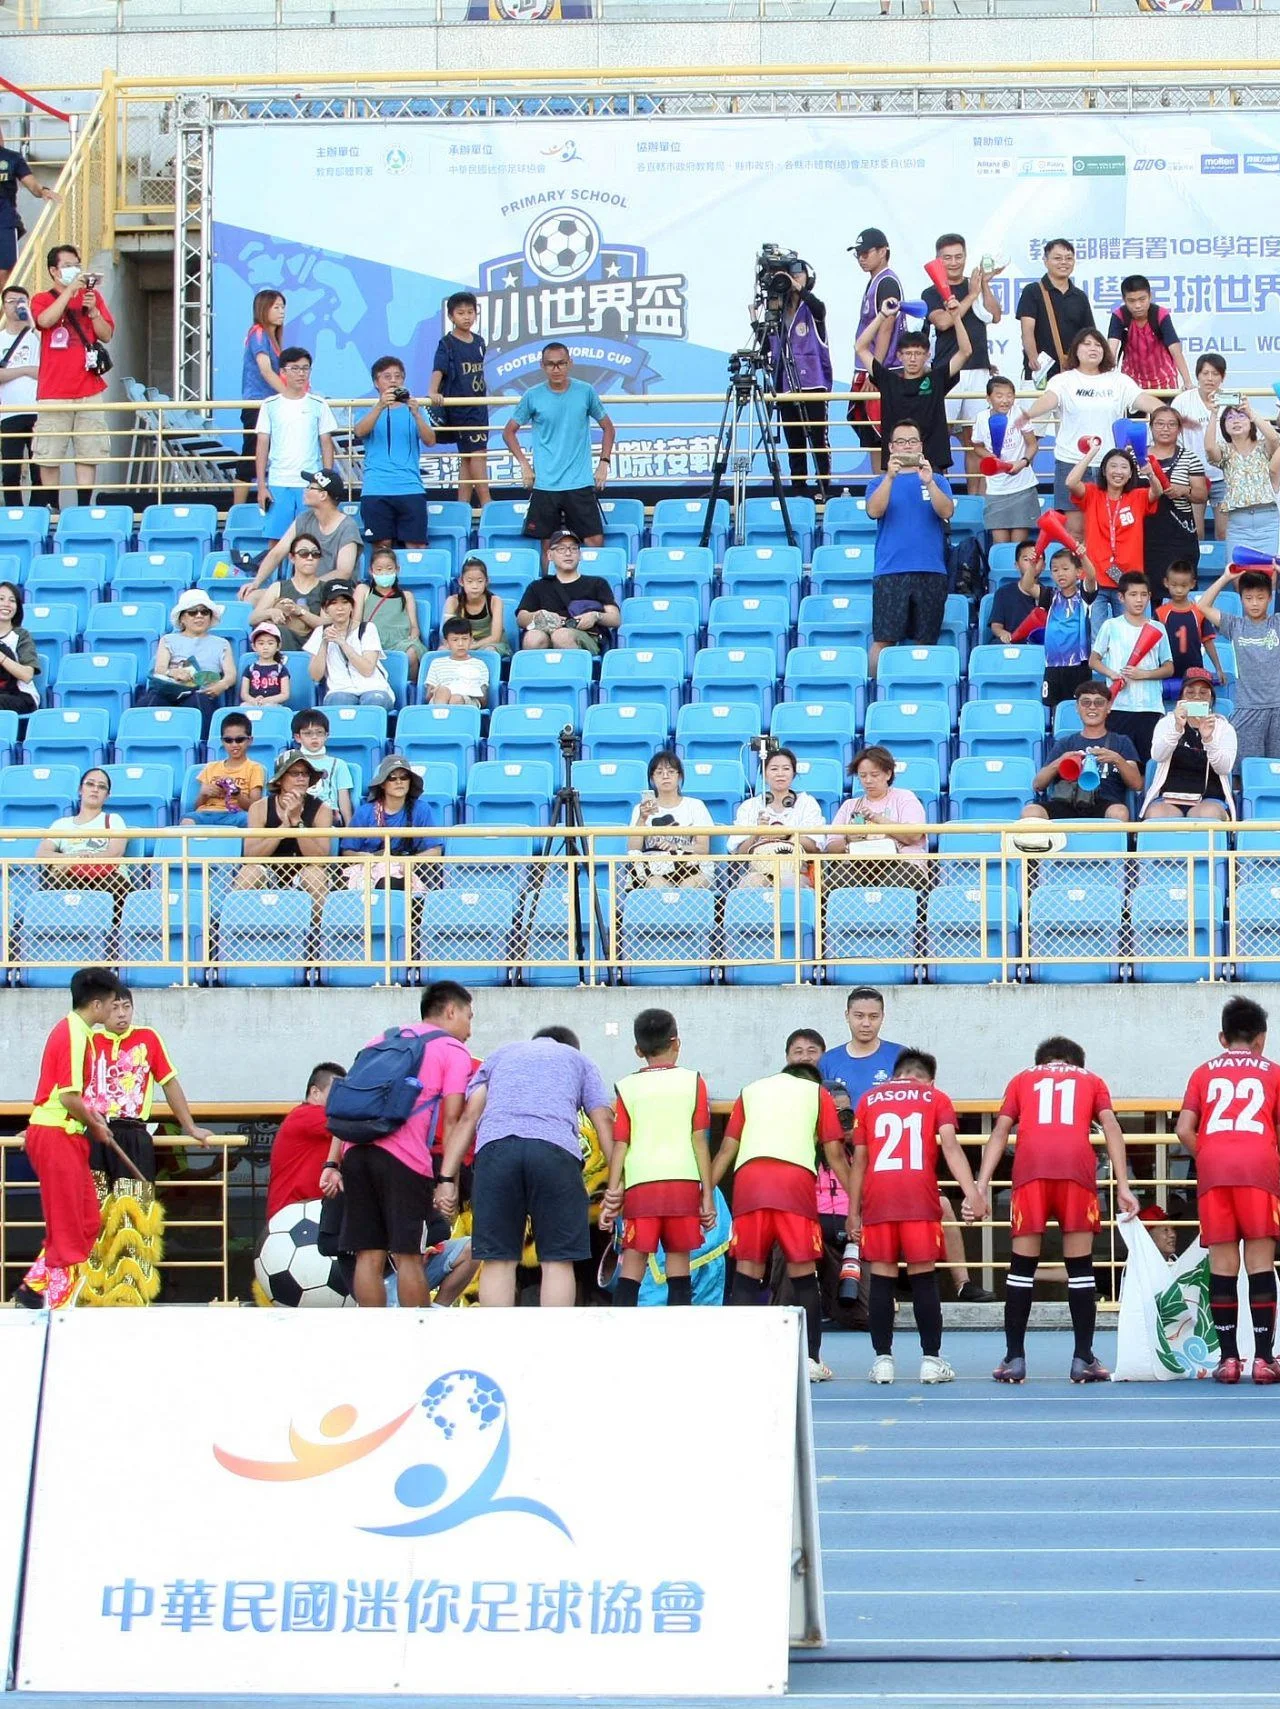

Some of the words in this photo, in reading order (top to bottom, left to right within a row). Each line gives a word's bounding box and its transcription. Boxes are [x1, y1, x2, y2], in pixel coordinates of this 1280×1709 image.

[316, 146, 360, 158] 主辦單位
[448, 144, 493, 156] 承辦單位
[501, 189, 566, 217] PRIMARY
[571, 189, 628, 208] SCHOOL
[497, 348, 543, 377] FOOTBA
[607, 351, 633, 366] CUP
[1076, 389, 1095, 398] NIKE
[1207, 1056, 1271, 1073] WAYNE
[866, 1090, 919, 1106] EASON
[922, 1089, 932, 1103] C
[1034, 1077, 1076, 1125] 11
[1206, 1077, 1265, 1135] 22
[874, 1112, 924, 1172] 21
[100, 1576, 706, 1636] 中華民國迷你足球協會
